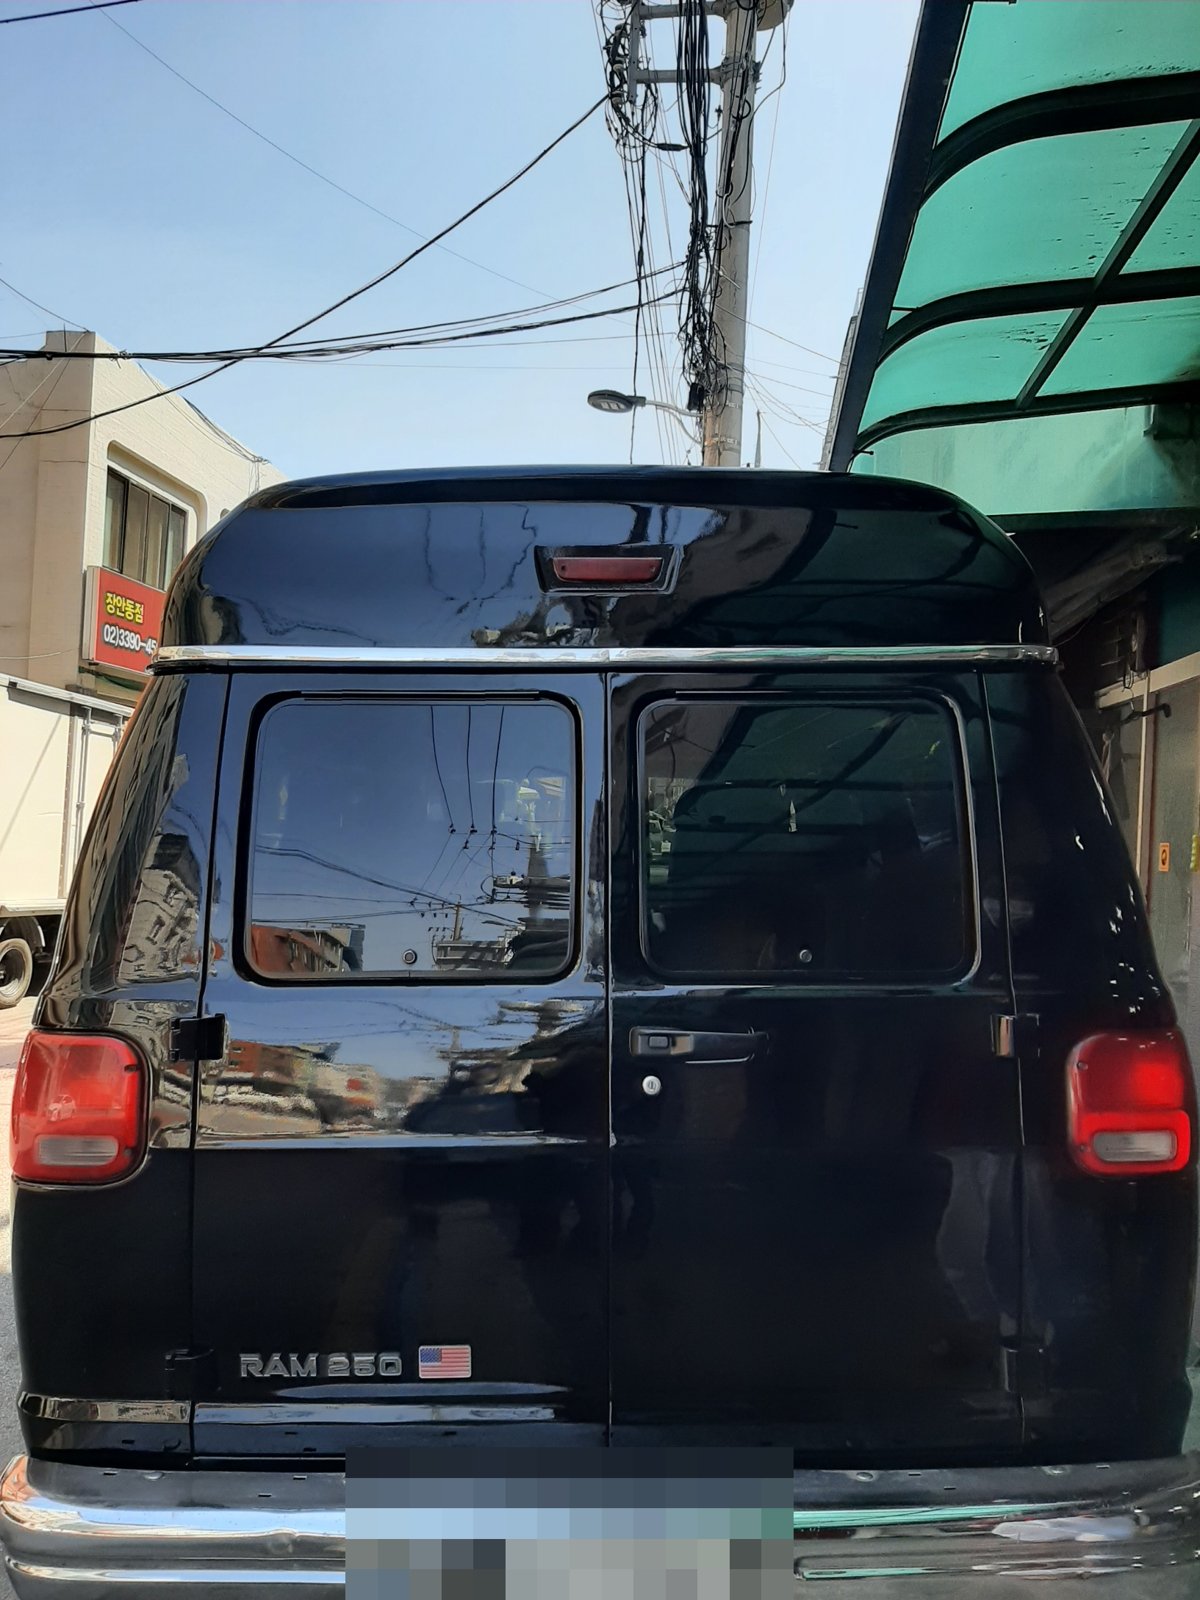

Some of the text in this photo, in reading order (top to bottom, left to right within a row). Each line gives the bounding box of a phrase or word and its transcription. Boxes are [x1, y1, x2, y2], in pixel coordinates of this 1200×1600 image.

[105, 592, 144, 624] 장안동점
[239, 1353, 402, 1377] RAM 250
